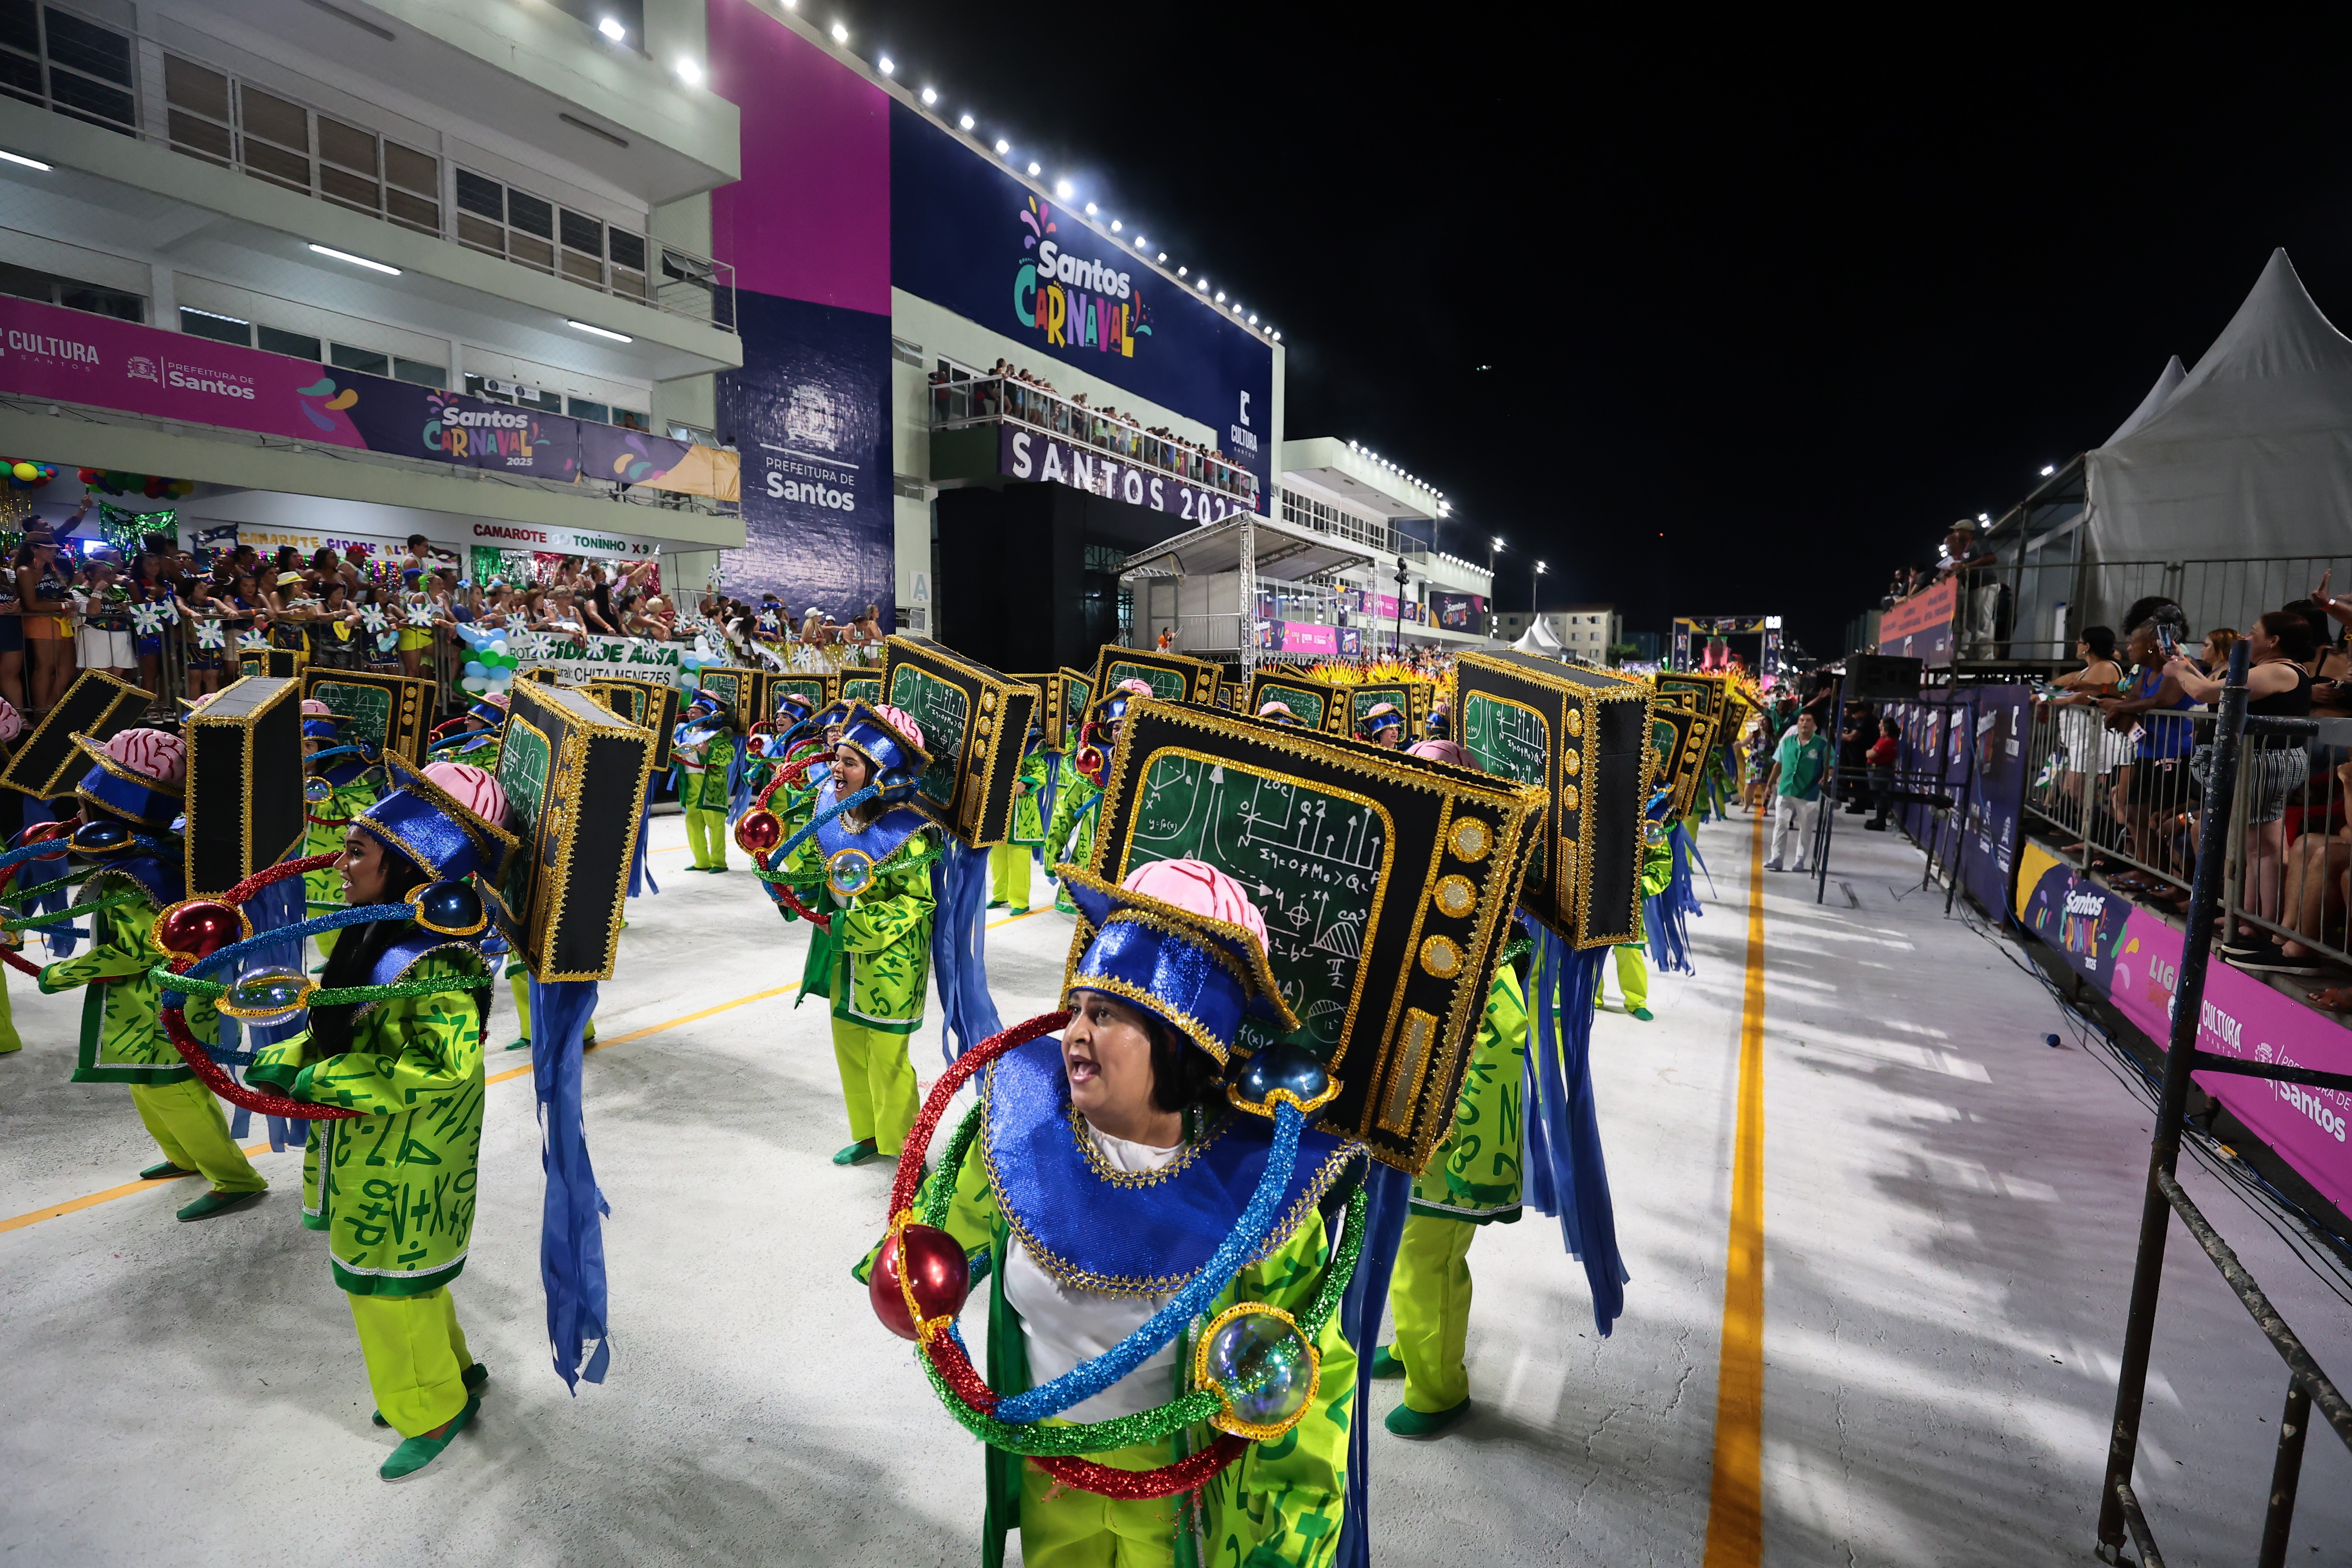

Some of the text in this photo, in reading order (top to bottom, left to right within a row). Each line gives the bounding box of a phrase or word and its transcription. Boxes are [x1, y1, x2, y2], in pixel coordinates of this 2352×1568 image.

[1037, 240, 1131, 299] Santos
[1014, 264, 1134, 358] CARNAVAL
[9, 330, 100, 365] CULTURA
[21, 354, 90, 372] SANTOS
[169, 361, 254, 384] PREFEITURA DE
[169, 370, 255, 400] Santos
[442, 407, 528, 428] Santos
[423, 420, 533, 458] CARNAVAL
[1231, 424, 1258, 452] CULTURA
[506, 457, 533, 467] 2025
[1234, 446, 1255, 459] SANTOS
[766, 457, 855, 486] PREFEITURA DE
[1012, 432, 1164, 512] SANTOS
[766, 472, 855, 512] Santos
[384, 545, 411, 556] ALT
[473, 524, 547, 543] CAMAROTE
[632, 543, 640, 554] X
[643, 544, 649, 554] 9
[913, 574, 928, 600] A
[2066, 890, 2105, 916] Santos
[2085, 956, 2097, 971] 2025
[2202, 999, 2243, 1053] CULTURA
[2279, 1081, 2346, 1142] Santos
[2336, 1092, 2352, 1111] DE
